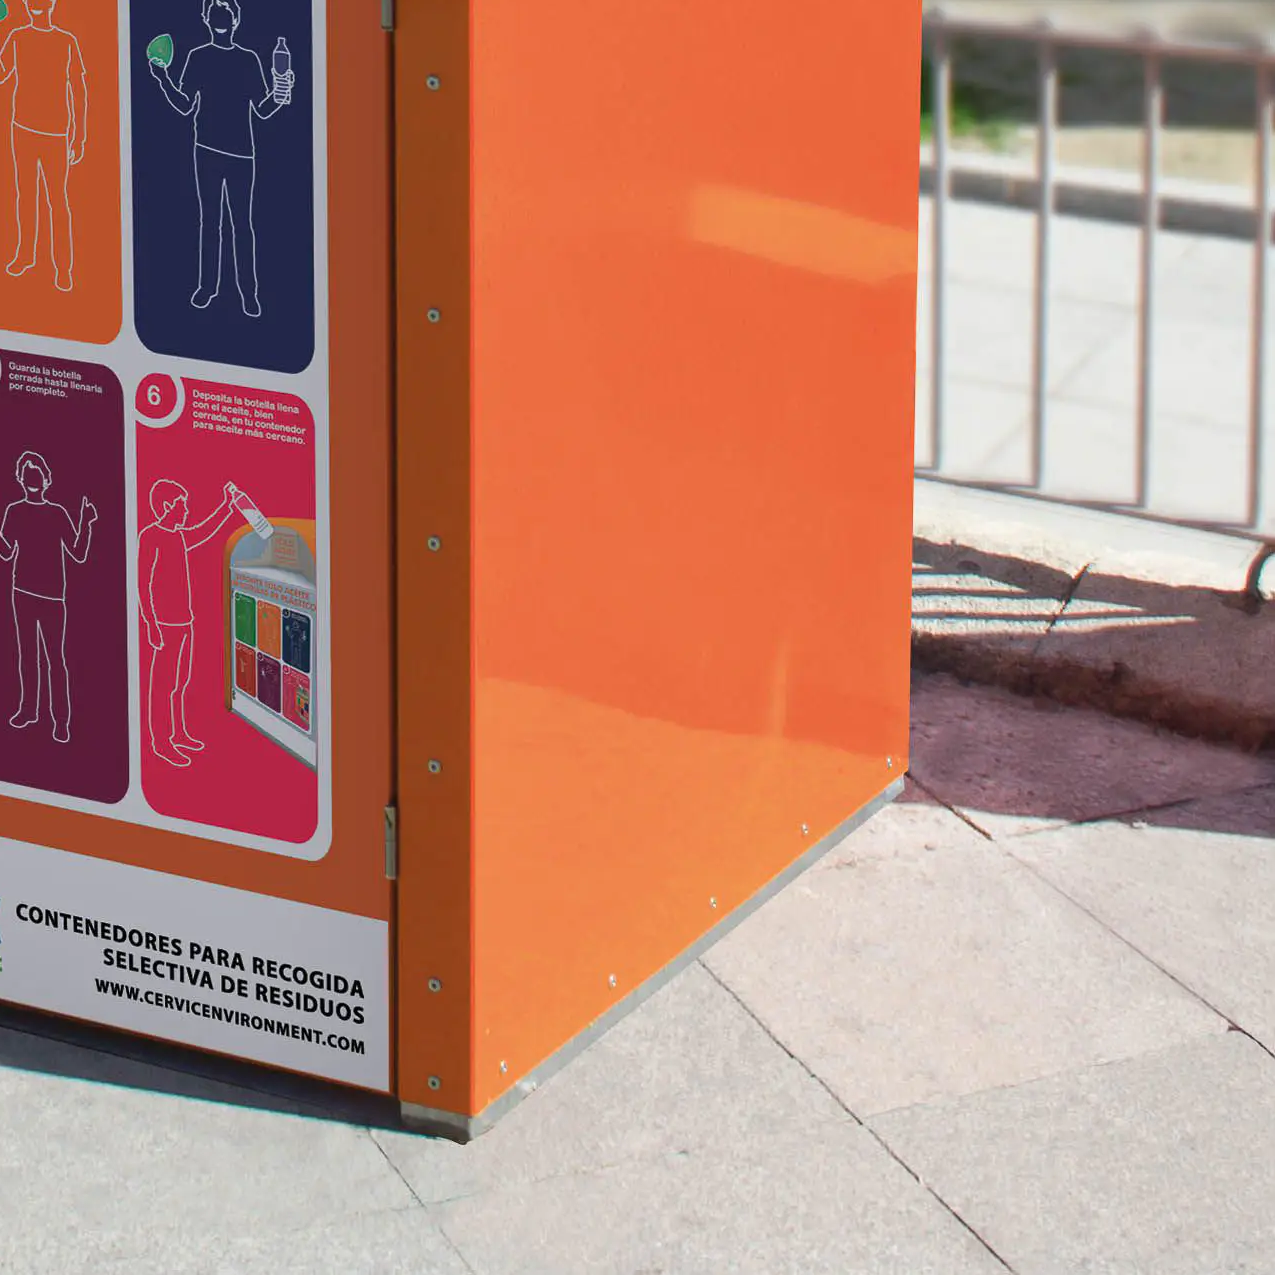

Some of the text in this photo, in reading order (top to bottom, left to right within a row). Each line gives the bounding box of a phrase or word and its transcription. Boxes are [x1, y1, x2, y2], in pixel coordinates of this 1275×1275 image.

[9, 362, 81, 380] Guarda la botella
[9, 372, 102, 393] cerrada hasta llenarla
[9, 383, 68, 398] por completo.
[147, 385, 161, 405] 6
[193, 389, 299, 414] Deposita la botella llena
[192, 401, 273, 419] con el aceite, bien
[192, 410, 306, 435] cerrada, en tu contenedor
[192, 420, 305, 445] para aceite más cercano.
[16, 903, 364, 998] CONTENEDORES PARA RECOGIDA
[103, 948, 365, 1025] SELECTIVA DE RESIDUOS
[95, 979, 365, 1055] WWW.CERVICENVIRONMENT.COM
